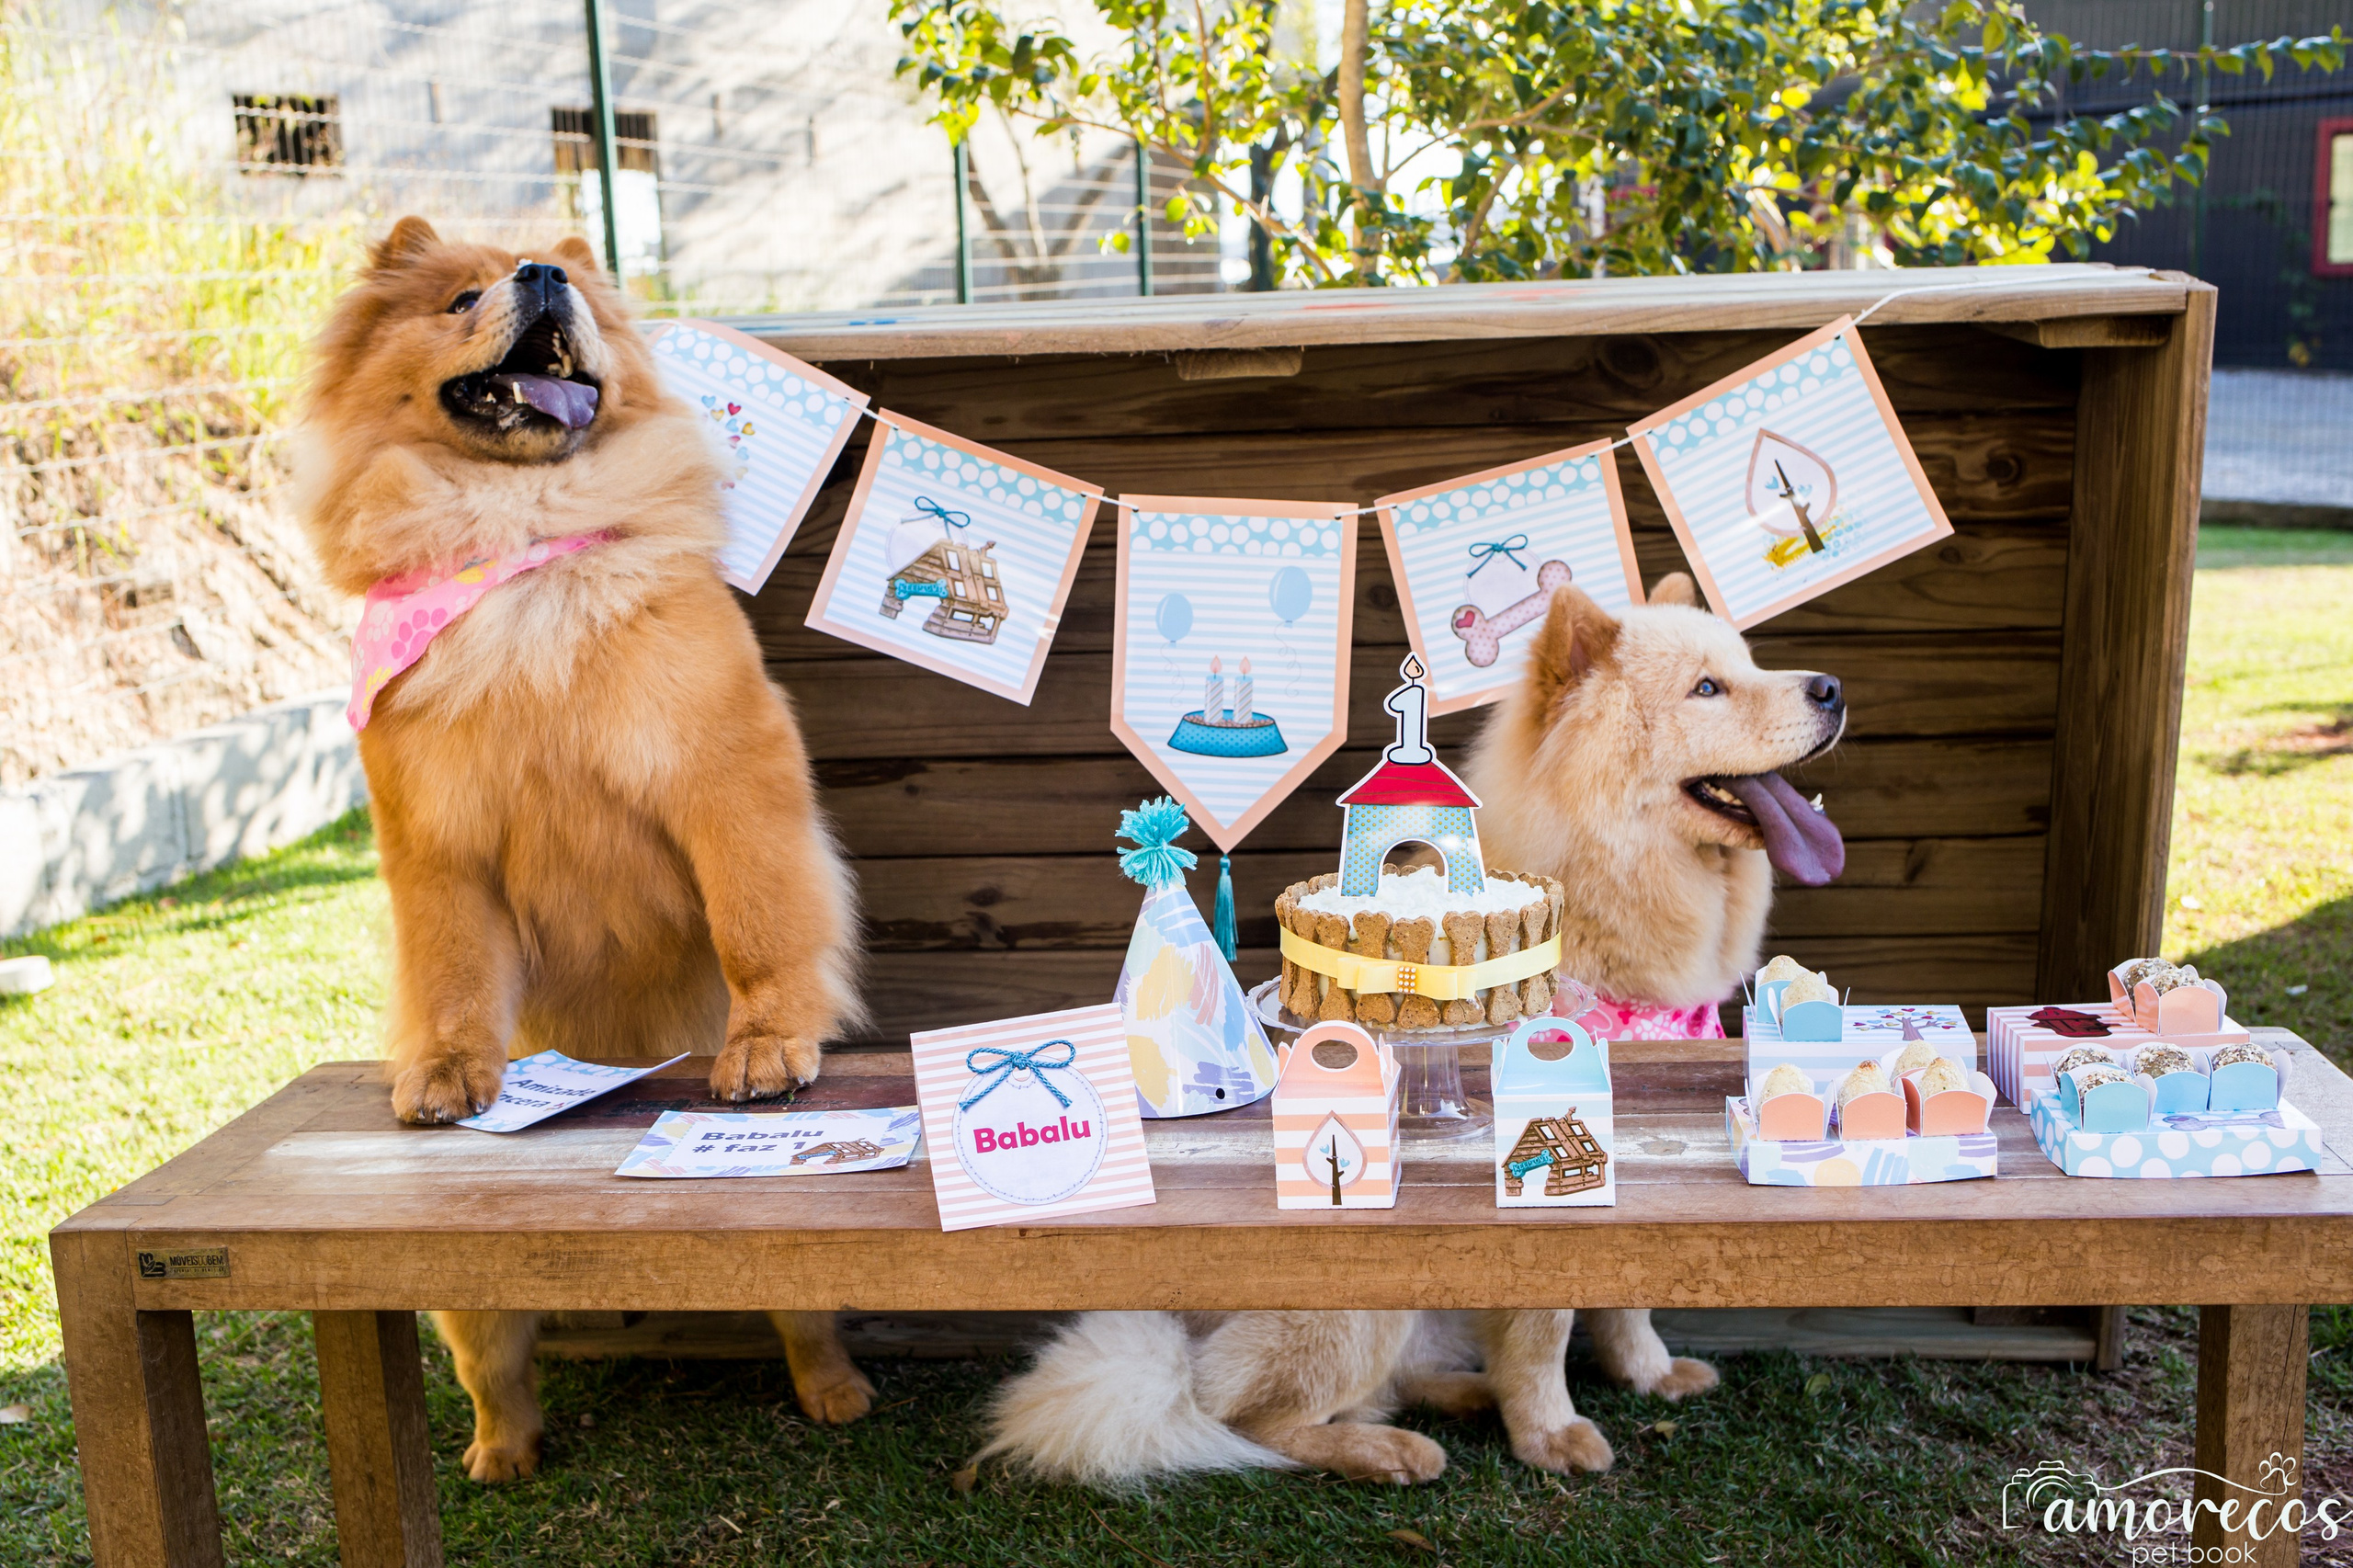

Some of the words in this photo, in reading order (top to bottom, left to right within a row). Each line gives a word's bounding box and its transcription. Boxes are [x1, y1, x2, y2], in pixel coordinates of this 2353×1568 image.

[1388, 684, 1433, 765] 1
[507, 1079, 597, 1096] Amizade
[498, 1090, 551, 1108] ncera
[700, 1130, 824, 1141] Babalu
[972, 1115, 1092, 1154] Babalu
[723, 1143, 779, 1153] faz
[793, 1141, 807, 1150] 1
